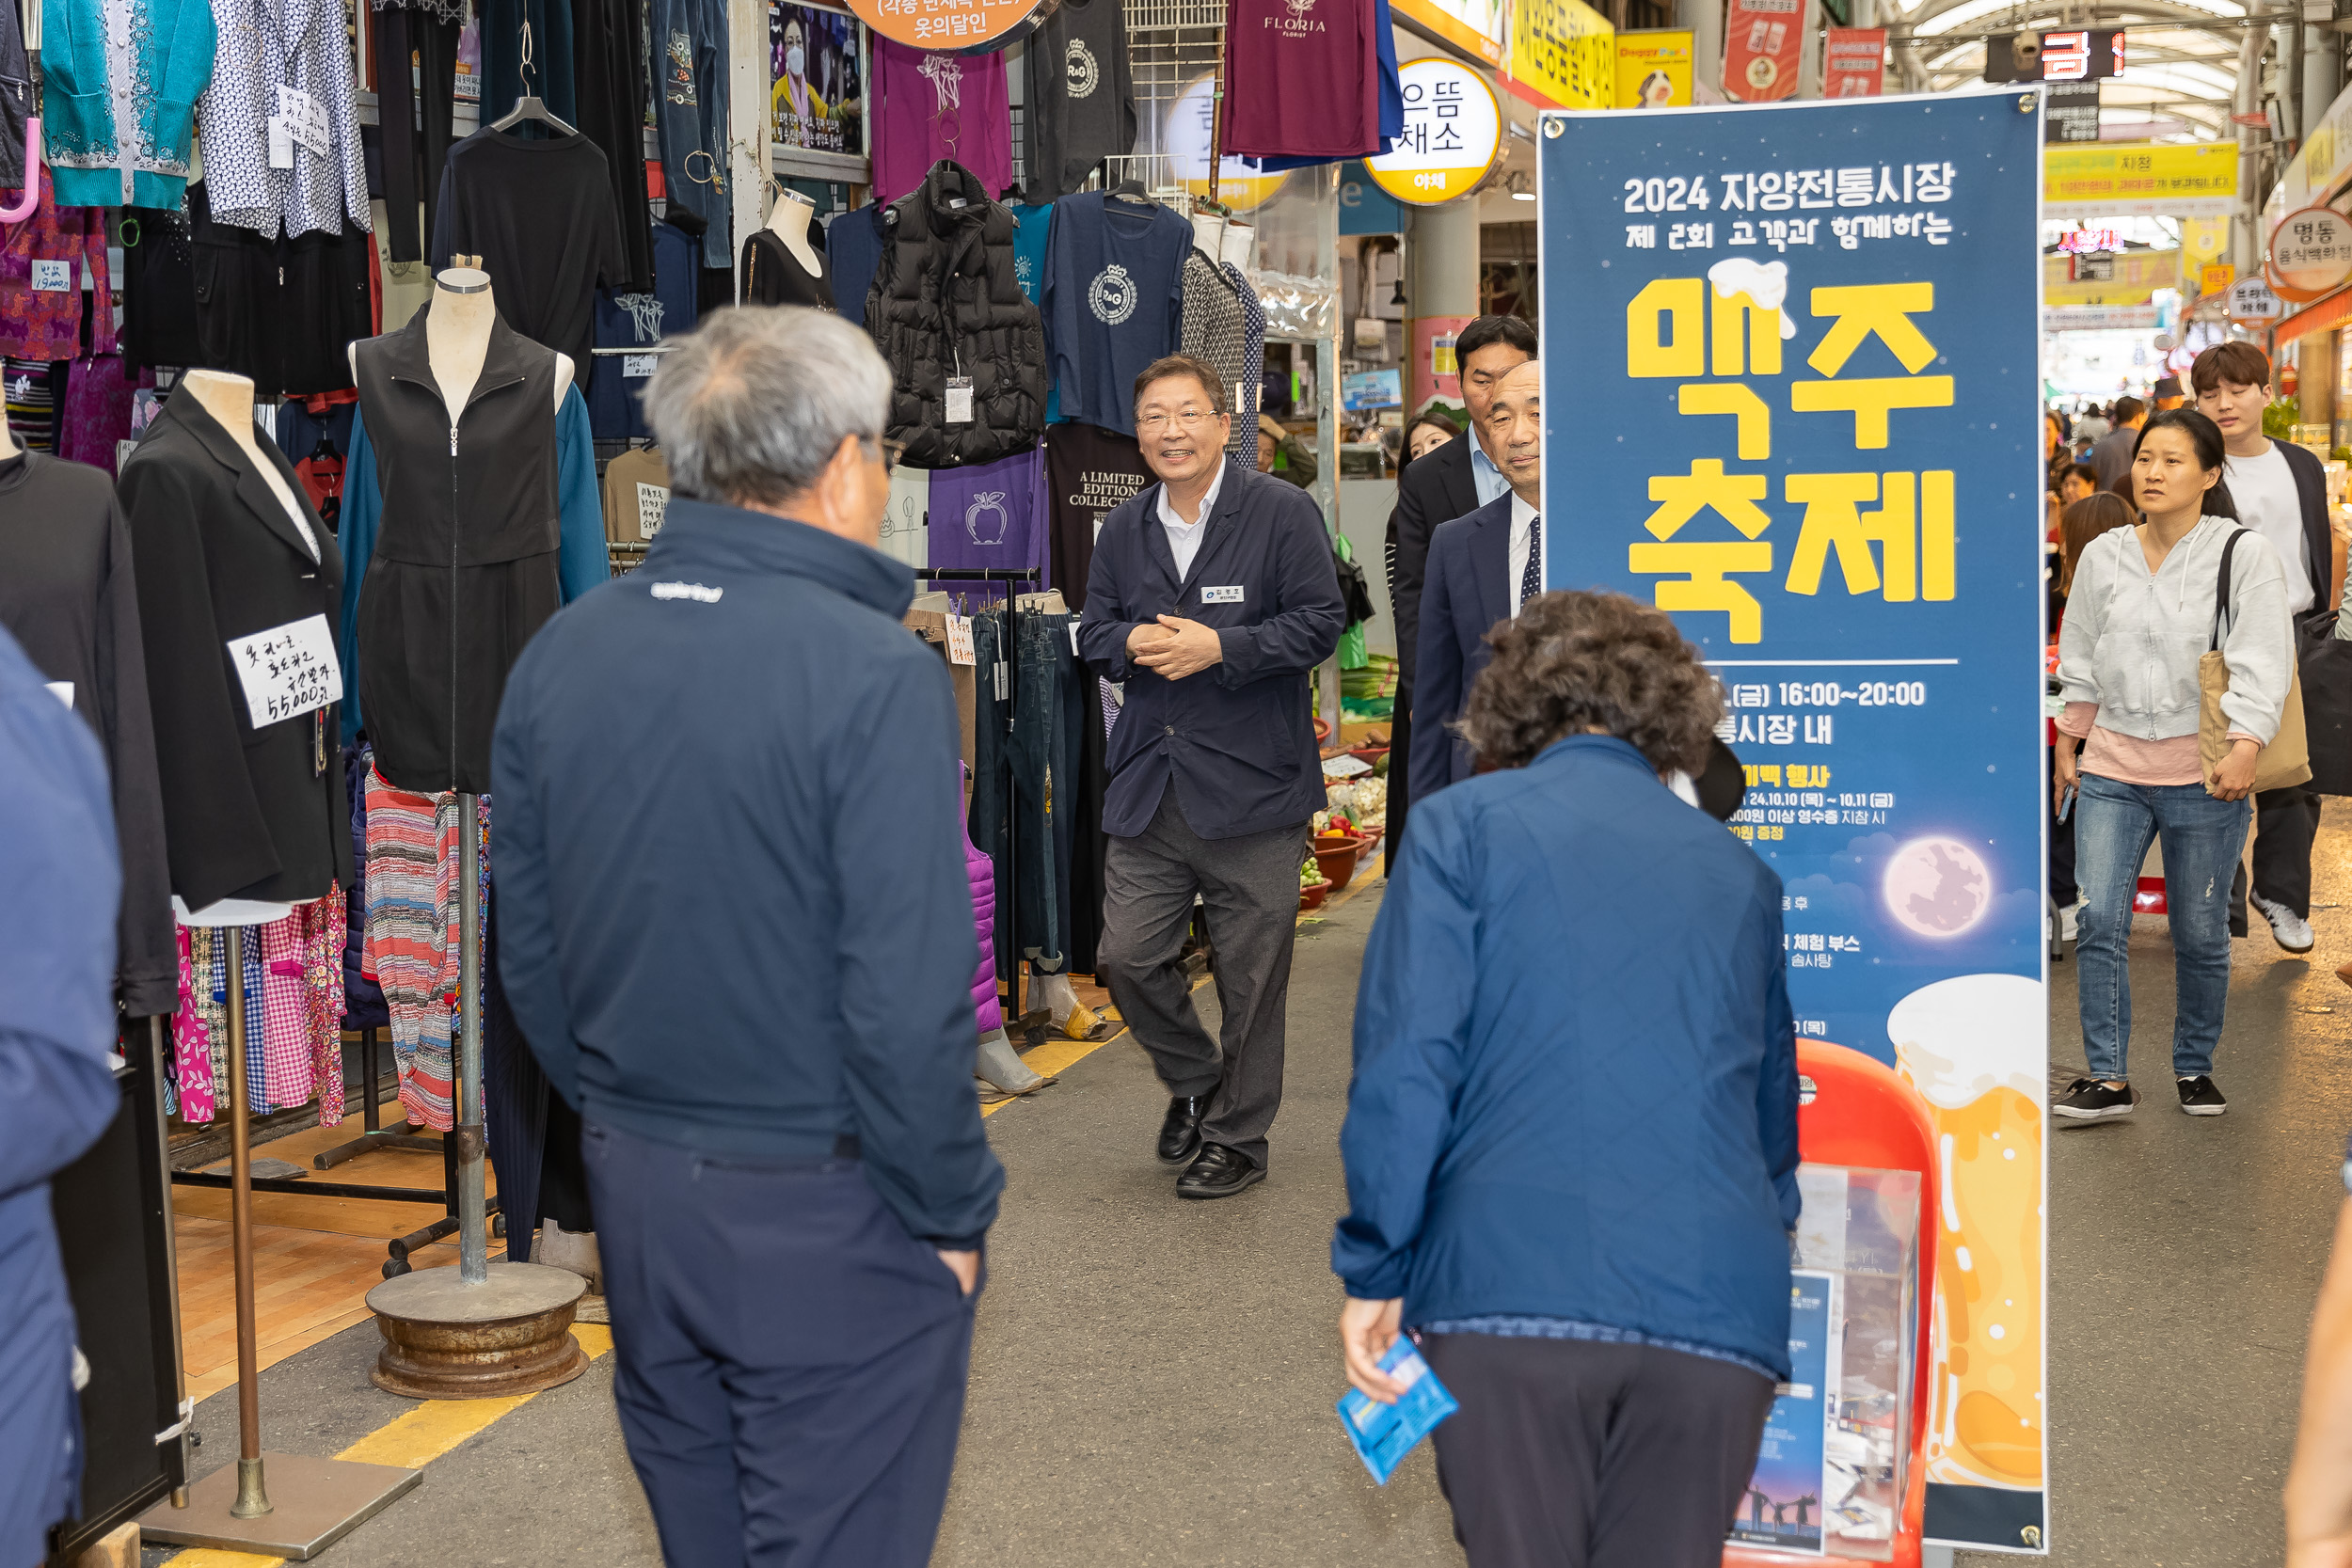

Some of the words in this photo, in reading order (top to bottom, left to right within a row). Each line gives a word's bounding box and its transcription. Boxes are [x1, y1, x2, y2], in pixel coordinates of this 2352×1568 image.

[914, 12, 987, 40] 옷의달인
[1264, 16, 1326, 32] FLORIA
[1403, 82, 1463, 118] 으뜸
[1398, 123, 1463, 154] 채소
[1414, 172, 1446, 191] 야채
[1624, 176, 1710, 214] 2024
[1720, 162, 1956, 213] 자양전통시장
[1626, 225, 1656, 249] 제
[1668, 223, 1713, 250] 2회
[1727, 218, 1820, 253] 고객과
[1831, 212, 1953, 250] 함께하는
[1103, 289, 1122, 305] R&G
[1627, 273, 1954, 460] 맥주
[1080, 471, 1088, 483] A
[1090, 471, 1145, 485] LIMITED
[1083, 483, 1138, 497] EDITION
[1069, 495, 1129, 508] COLLECT
[1629, 458, 1955, 644] 축제
[1778, 681, 1926, 707] 16:00~20:00
[1804, 714, 1833, 745] 내
[1786, 763, 1831, 788] 행사
[1750, 793, 1798, 807] 24.10.10
[1800, 792, 1824, 808] (목)
[1839, 793, 1867, 807] 10.11
[1869, 792, 1894, 808] (금)
[1768, 809, 1796, 824] 이상
[1797, 810, 1838, 825] 영수증
[1841, 810, 1868, 825] 지참
[1871, 810, 1885, 825] 시
[1794, 896, 1808, 911] 후
[1793, 933, 1824, 951] 체험
[1828, 935, 1861, 952] 부스
[1791, 953, 1832, 969] 솜사탕
[1803, 1020, 1826, 1036] (목)
